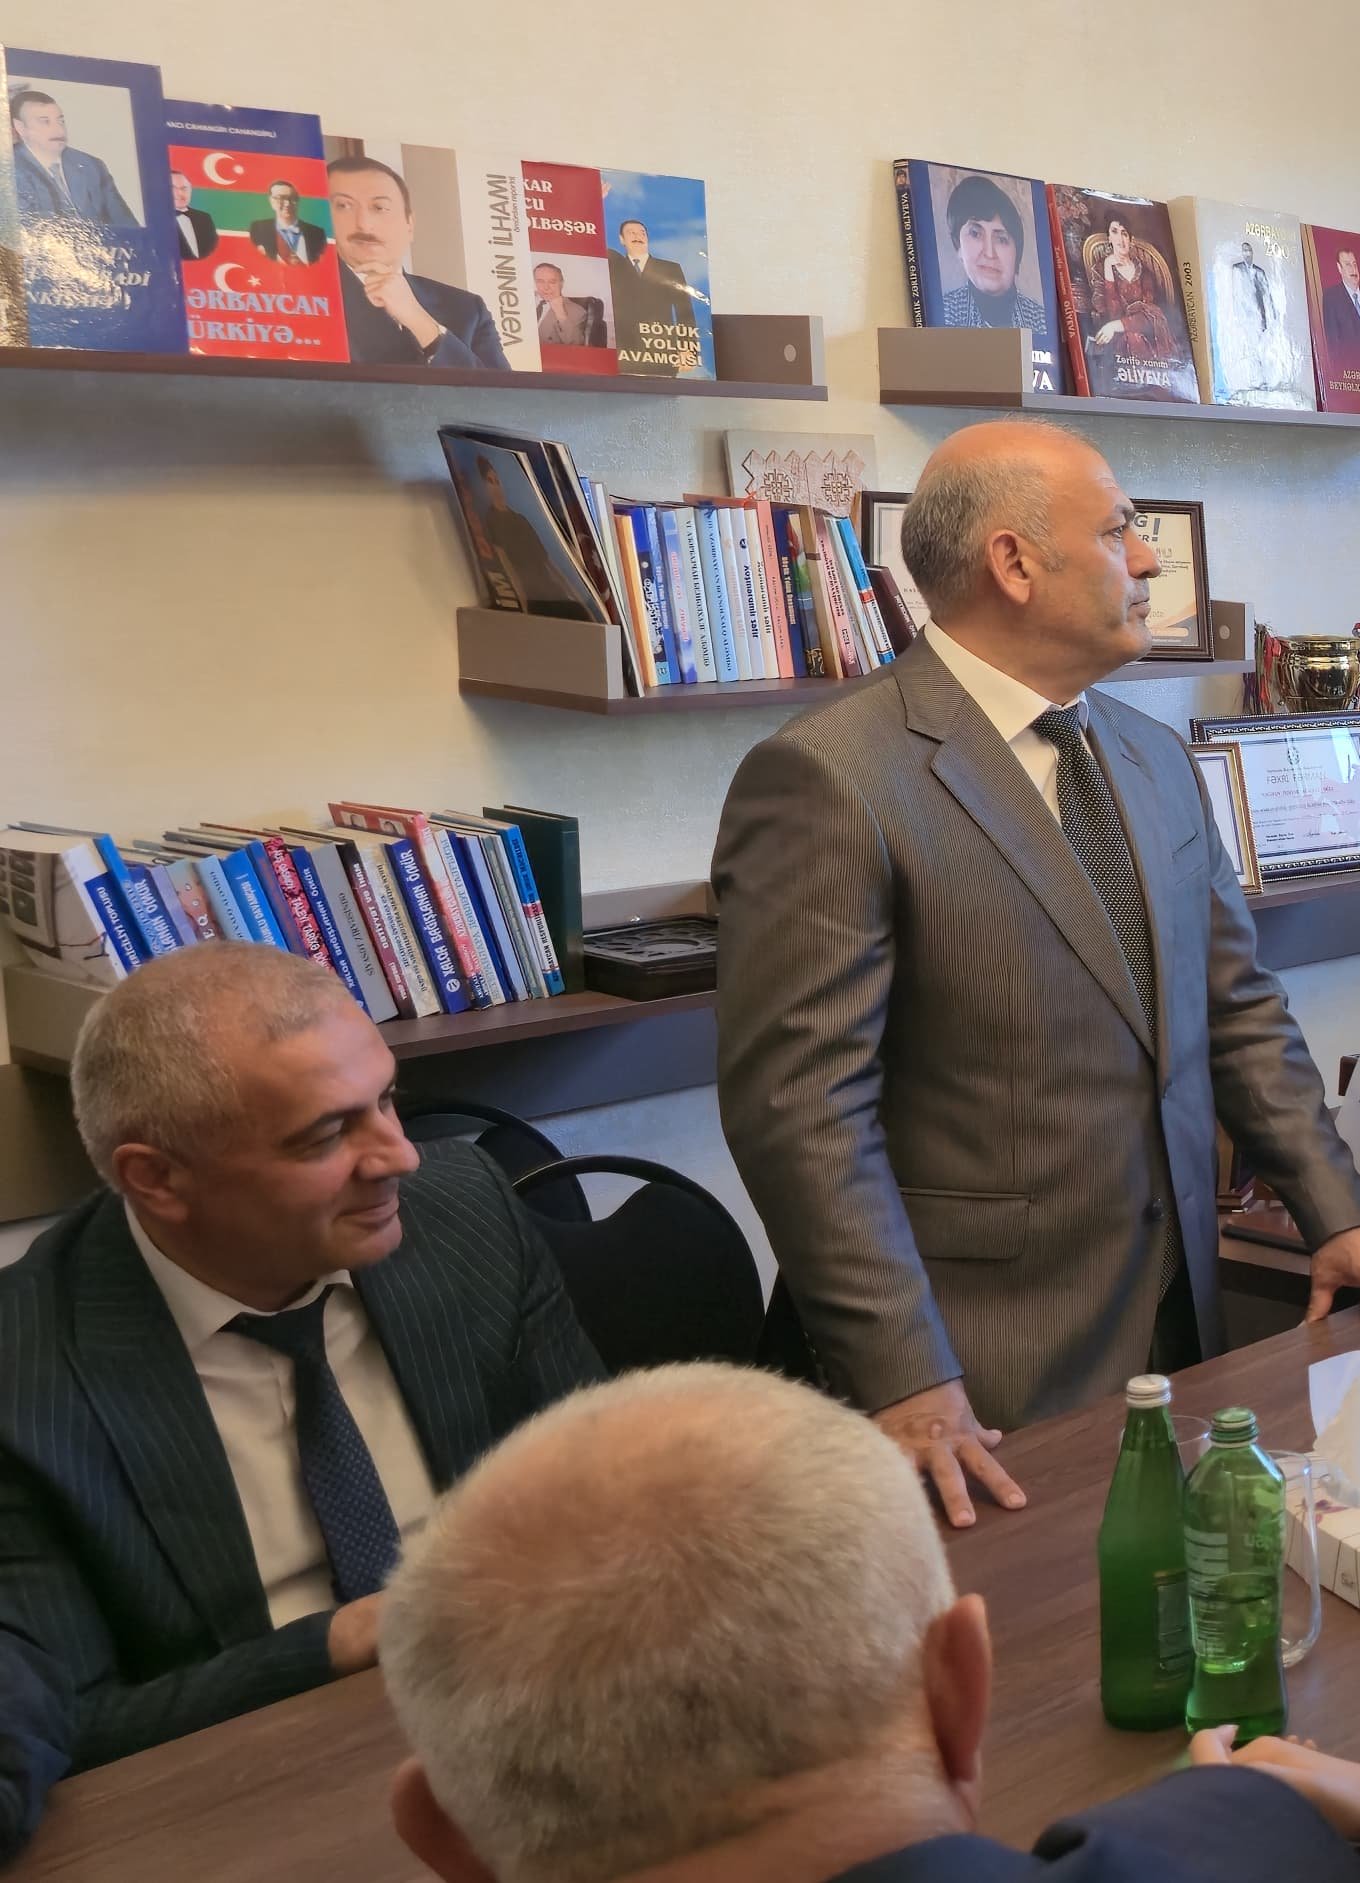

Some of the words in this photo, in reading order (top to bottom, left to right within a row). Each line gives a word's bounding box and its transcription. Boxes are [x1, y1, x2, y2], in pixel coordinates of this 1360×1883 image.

[1182, 261, 1193, 287] 2003
[188, 287, 330, 317] ƏRBAYCAN
[491, 254, 523, 347] VƏTƏNİN
[639, 322, 700, 338] BÖYÜK
[641, 337, 702, 352] YOLUN
[396, 848, 423, 883] ÖMÜR
[407, 882, 446, 945] BAĞIŞLANAN
[433, 943, 457, 977] XALQA
